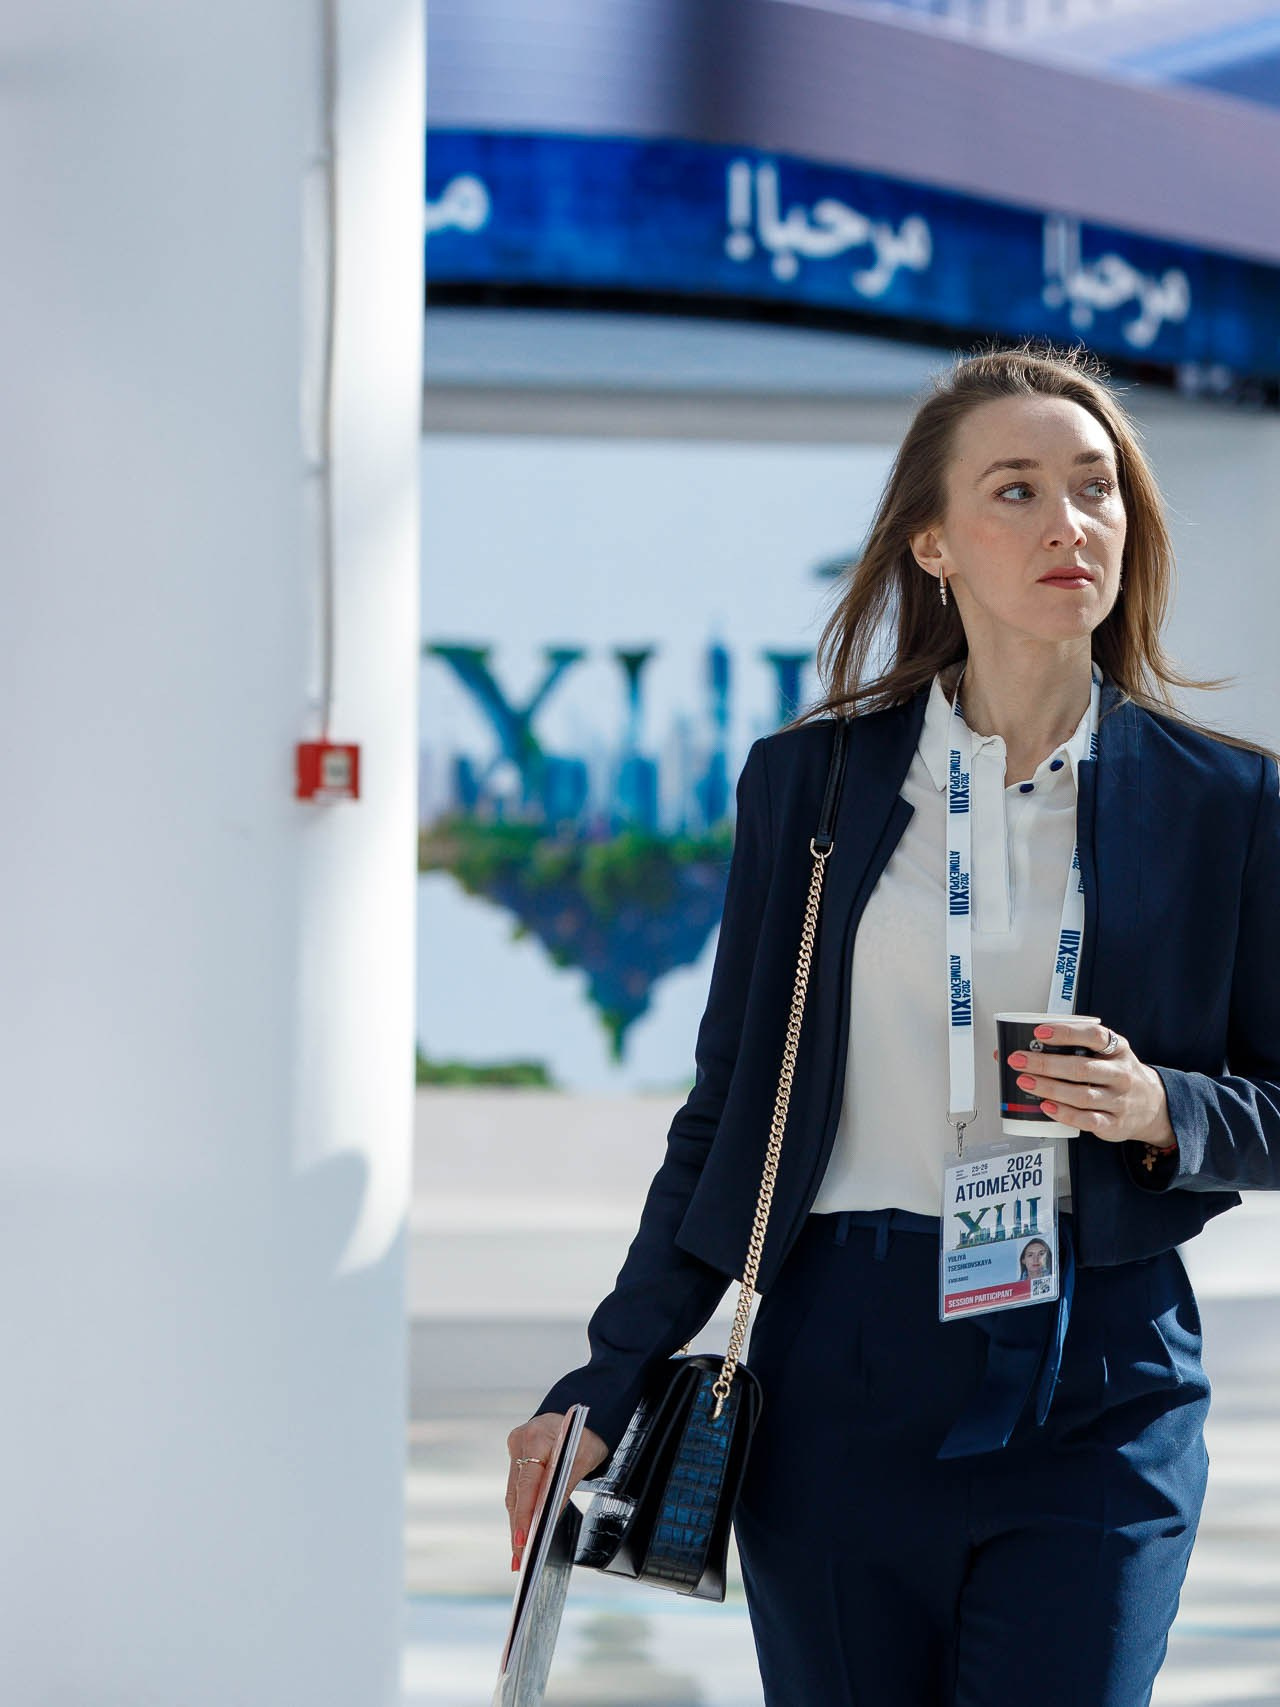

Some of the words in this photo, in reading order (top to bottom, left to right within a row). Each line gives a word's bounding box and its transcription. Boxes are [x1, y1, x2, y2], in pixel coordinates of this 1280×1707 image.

[725, 160, 932, 296] مرحبا!
[950, 749, 961, 791] ATOMEXPO
[950, 789, 970, 814] XIII
[949, 850, 961, 890] ATOMEXPO
[960, 872, 969, 889] 2024
[949, 889, 969, 915] XIII
[1059, 929, 1081, 956] XIII
[950, 955, 962, 998] ATOMEXPO
[1056, 956, 1066, 974] 2024
[961, 979, 971, 998] 2024
[1061, 957, 1078, 1001] ATOMEXPO
[951, 998, 972, 1026] XIII
[1007, 1153, 1042, 1173] 2024
[955, 1168, 1042, 1203] ATOMEXPO
[948, 1296, 974, 1308] SESSION
[974, 1289, 1014, 1303] PARTICIPANT
